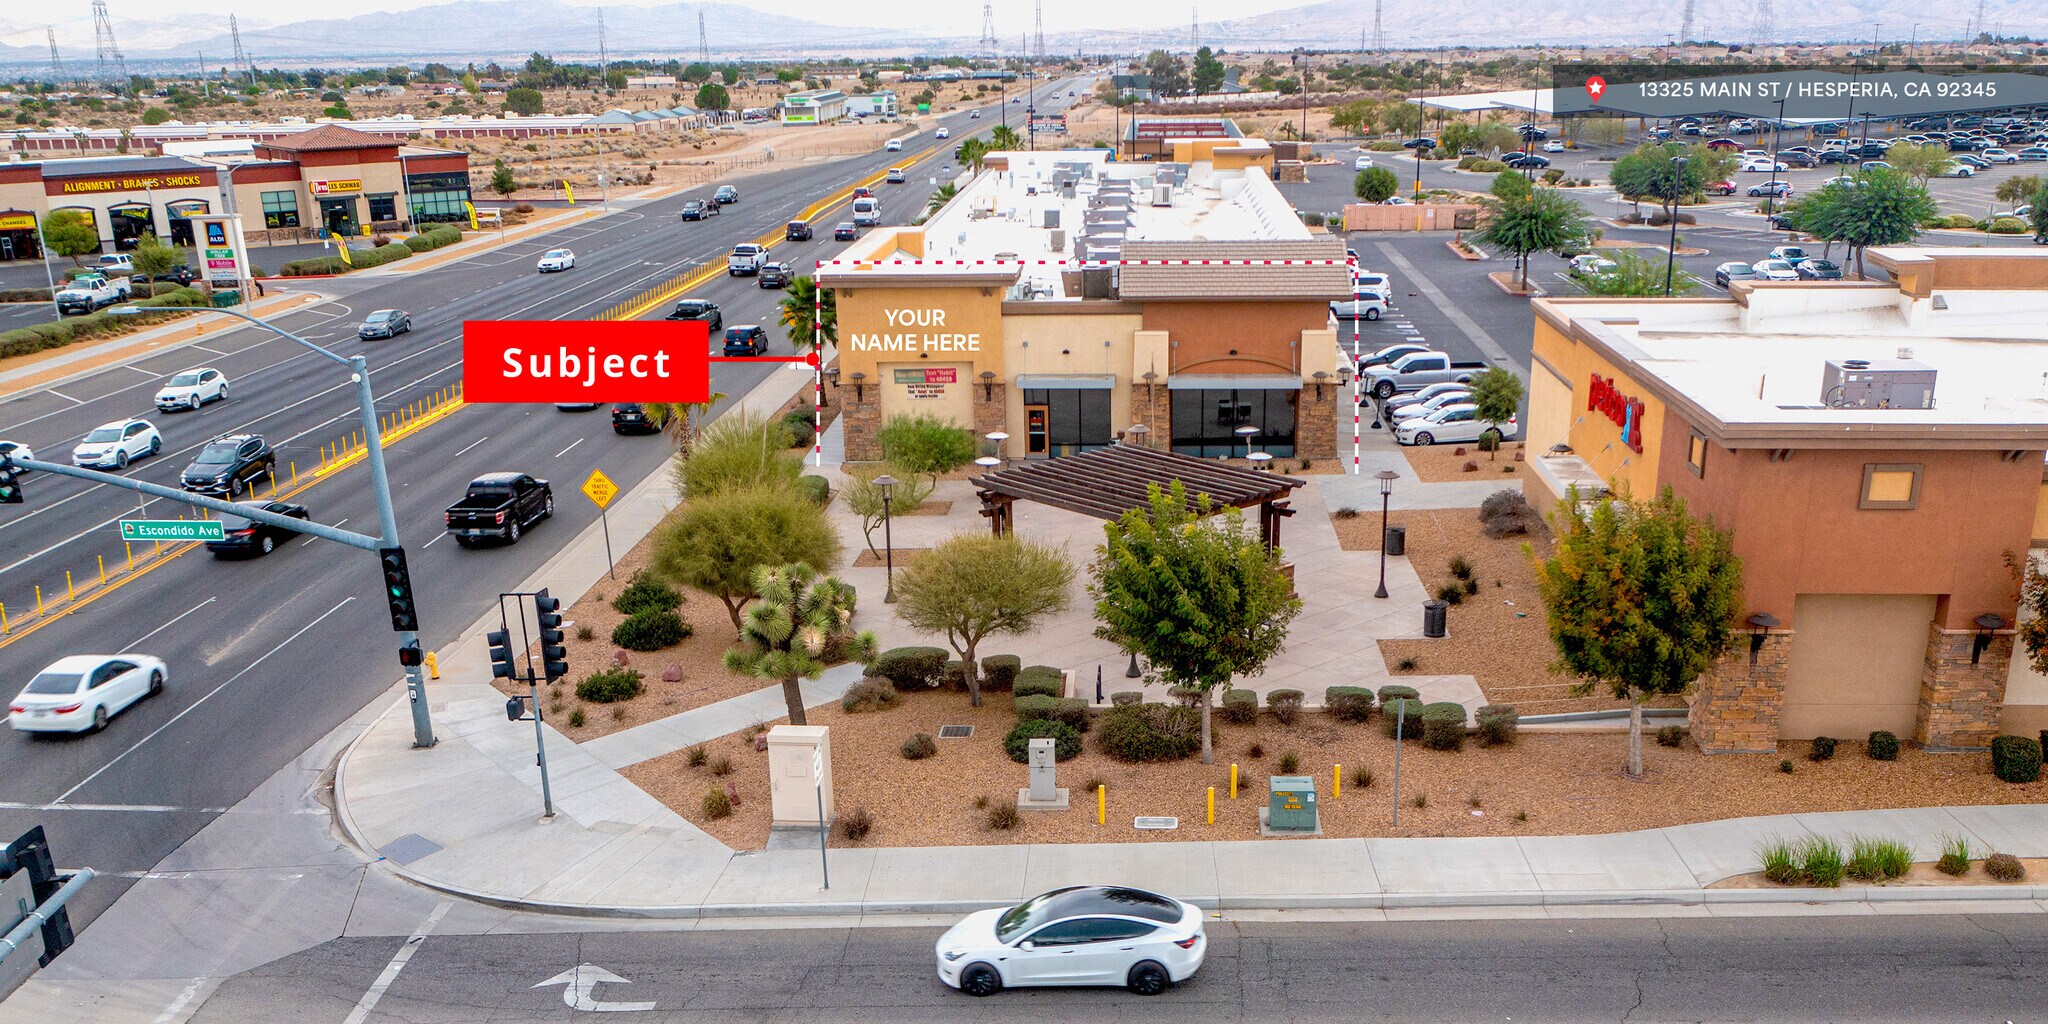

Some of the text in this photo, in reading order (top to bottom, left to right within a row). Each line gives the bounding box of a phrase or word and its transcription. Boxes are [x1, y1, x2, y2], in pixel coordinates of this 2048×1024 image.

[64, 175, 201, 192] ALIGNMENT BRAKES SHOCKS
[1588, 372, 1628, 428] petco
[139, 525, 220, 536] Escondido Ave
